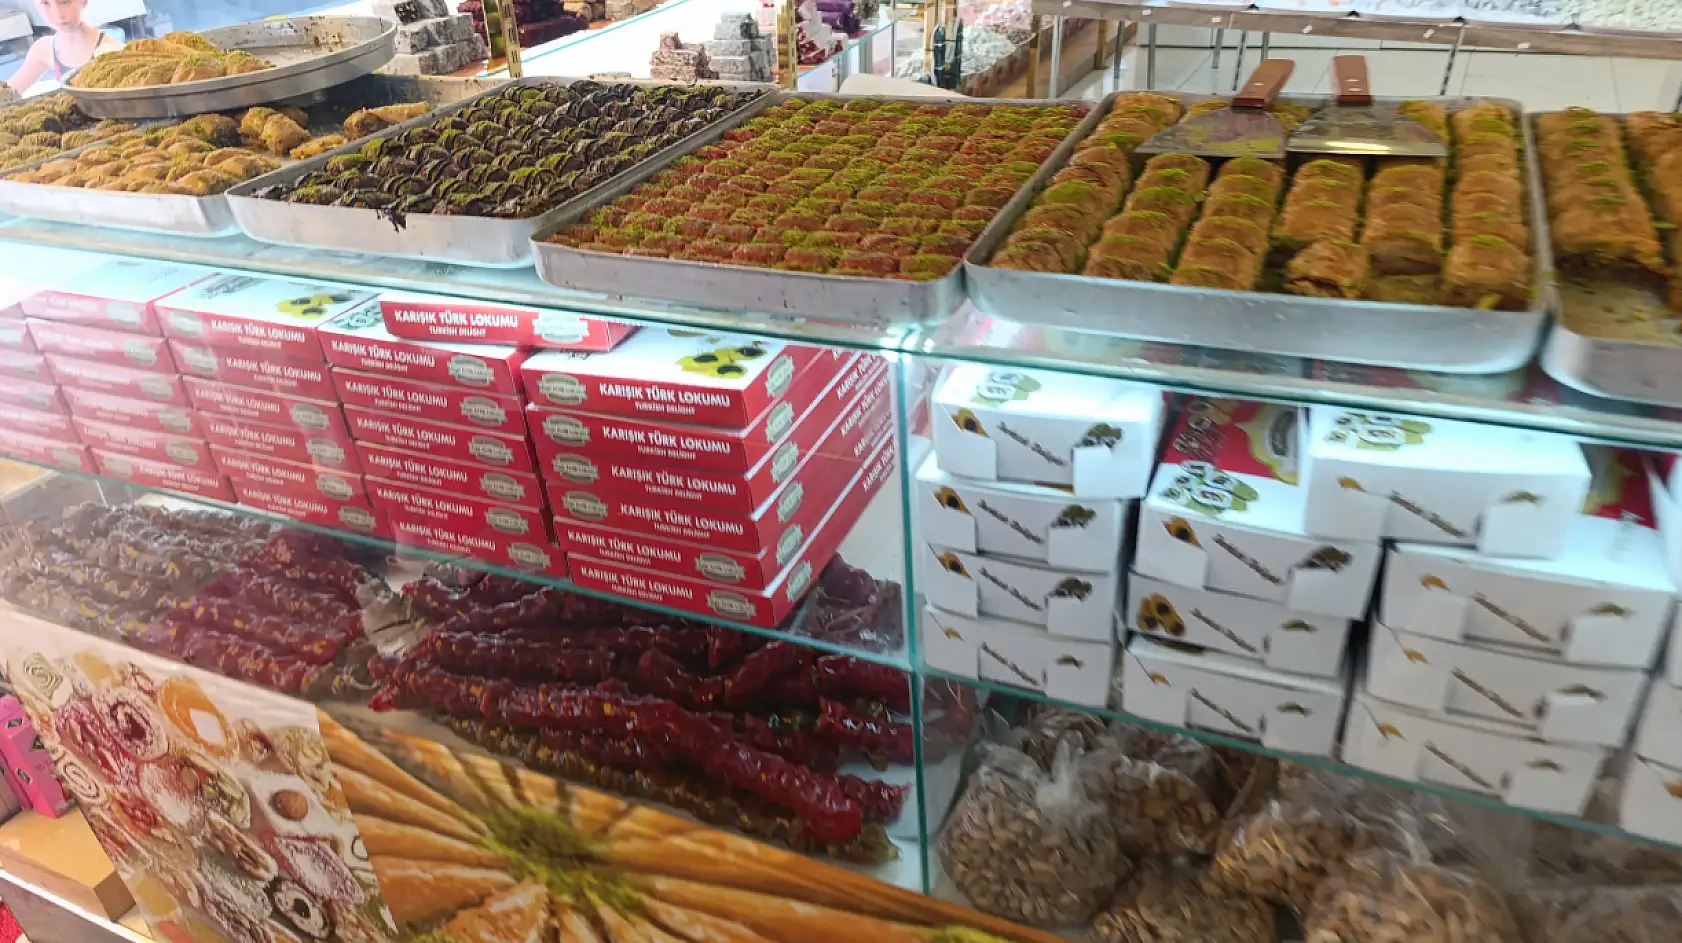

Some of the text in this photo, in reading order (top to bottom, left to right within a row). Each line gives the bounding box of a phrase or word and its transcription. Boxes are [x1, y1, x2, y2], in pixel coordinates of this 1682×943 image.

[395, 310, 436, 326] KARIŞIK
[439, 309, 467, 325] TÜRK
[470, 313, 519, 328] LOKUMU
[369, 344, 392, 361] TÜRK
[394, 350, 435, 368] LOKUMU
[382, 385, 405, 402] TÜRK
[407, 392, 448, 408] LOKUMU
[599, 383, 643, 401] KARIŞIK
[645, 385, 676, 403] TÜRK
[678, 391, 730, 408] LOKUMU
[392, 423, 415, 438] TÜRK
[416, 429, 456, 446] LOKUMU
[602, 426, 646, 444] KARIŞIK
[648, 431, 677, 449] TÜRK
[680, 437, 730, 454] LOKUMU
[404, 459, 426, 474] TÜRK
[428, 465, 468, 482] LOKUMU
[611, 466, 653, 484] KARIŞIK
[655, 471, 683, 487] TÜRK
[687, 478, 737, 495] LOKUMU
[411, 493, 433, 508] TÜRK
[435, 500, 474, 517] LOKUMU
[620, 503, 662, 522] KARIŞIK
[664, 509, 692, 526] TÜRK
[695, 517, 744, 535] LOKUMU
[434, 526, 455, 542] TÜRK
[567, 530, 681, 562] KARIŞIK TÜRK LOKUMU
[581, 567, 693, 600] KARIŞIK TÜRK LOKUMU
